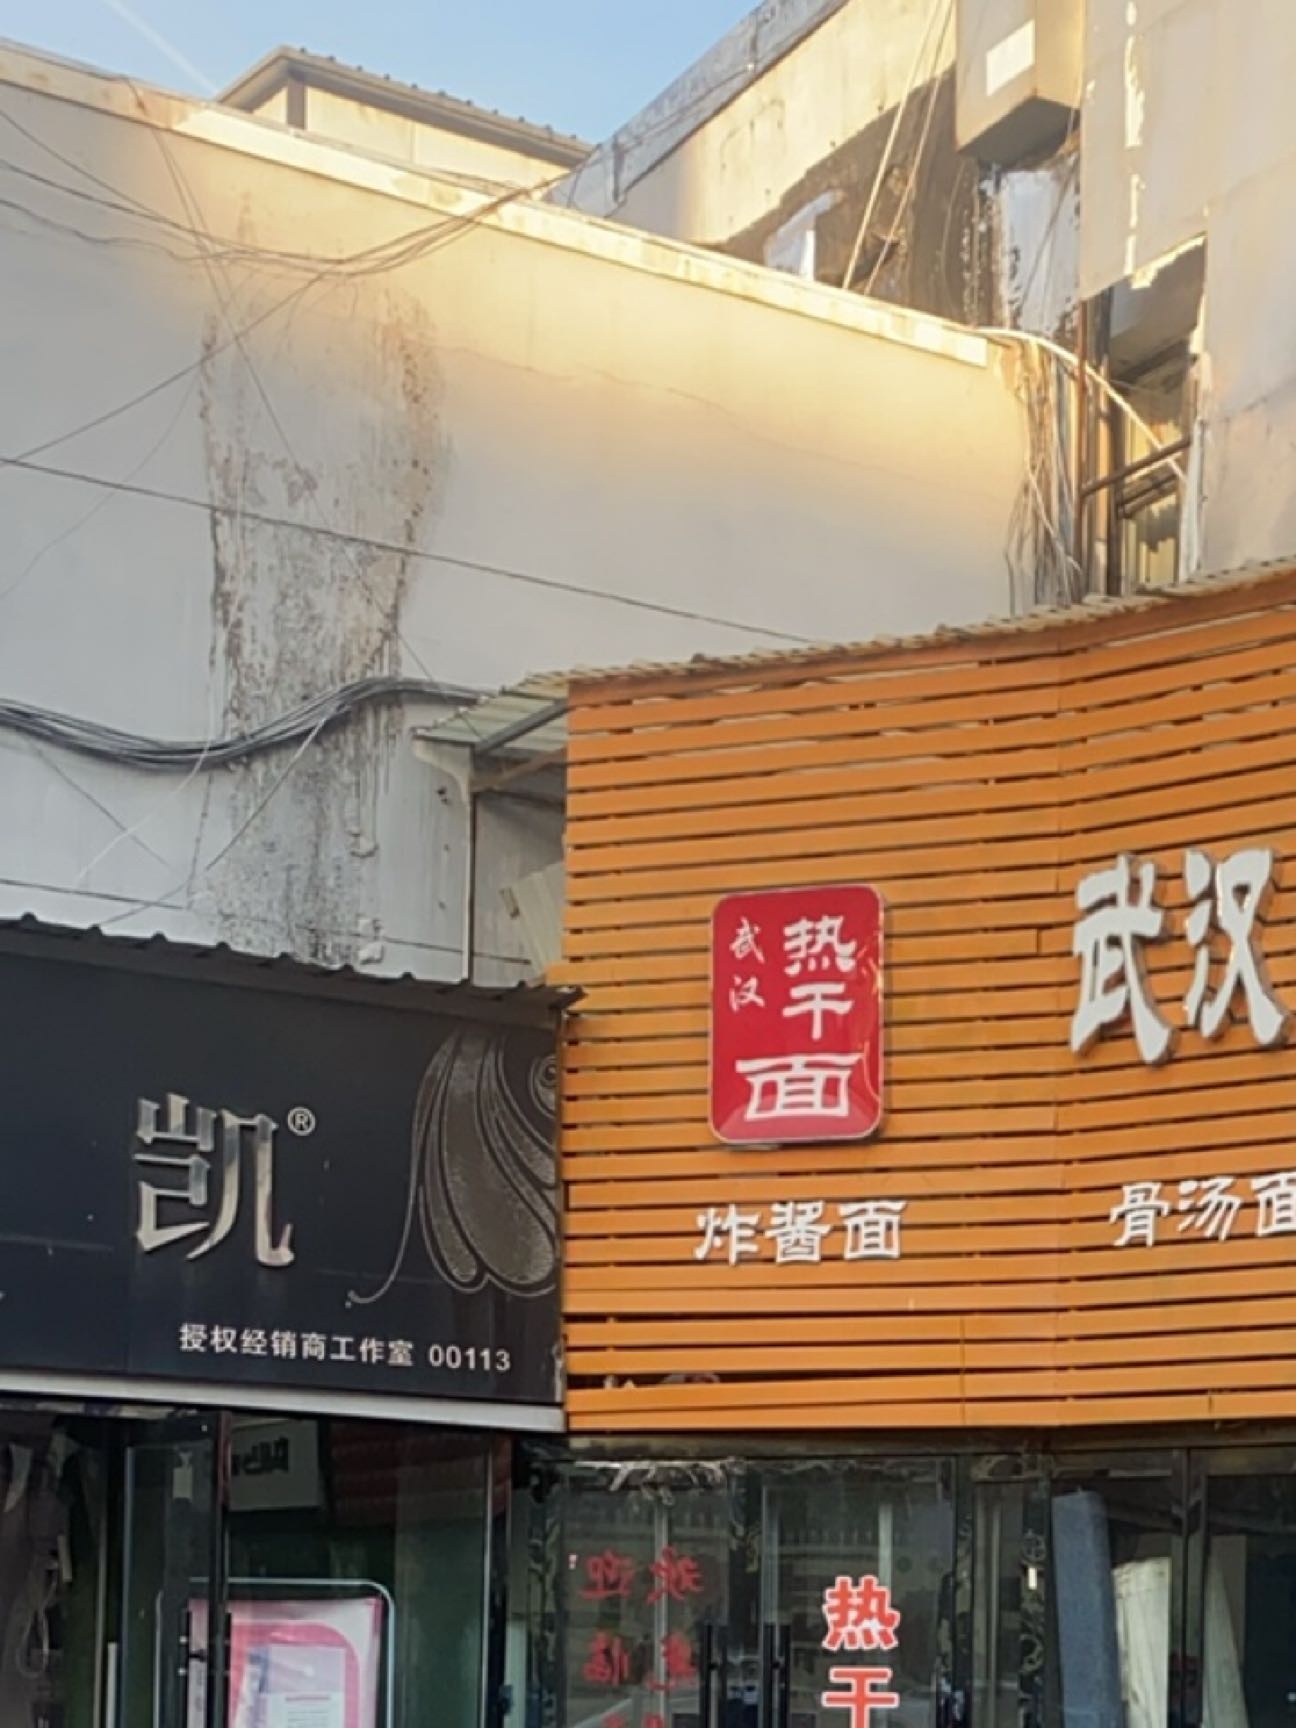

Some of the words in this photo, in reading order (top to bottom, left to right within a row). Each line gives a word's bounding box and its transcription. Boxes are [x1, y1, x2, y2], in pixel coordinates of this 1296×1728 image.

[729, 917, 766, 1013] 武汉
[735, 915, 862, 1122] 热干面
[134, 1094, 295, 1267] 凯
[179, 1322, 414, 1367] 授权经销商工作室
[428, 1343, 512, 1371] 00113
